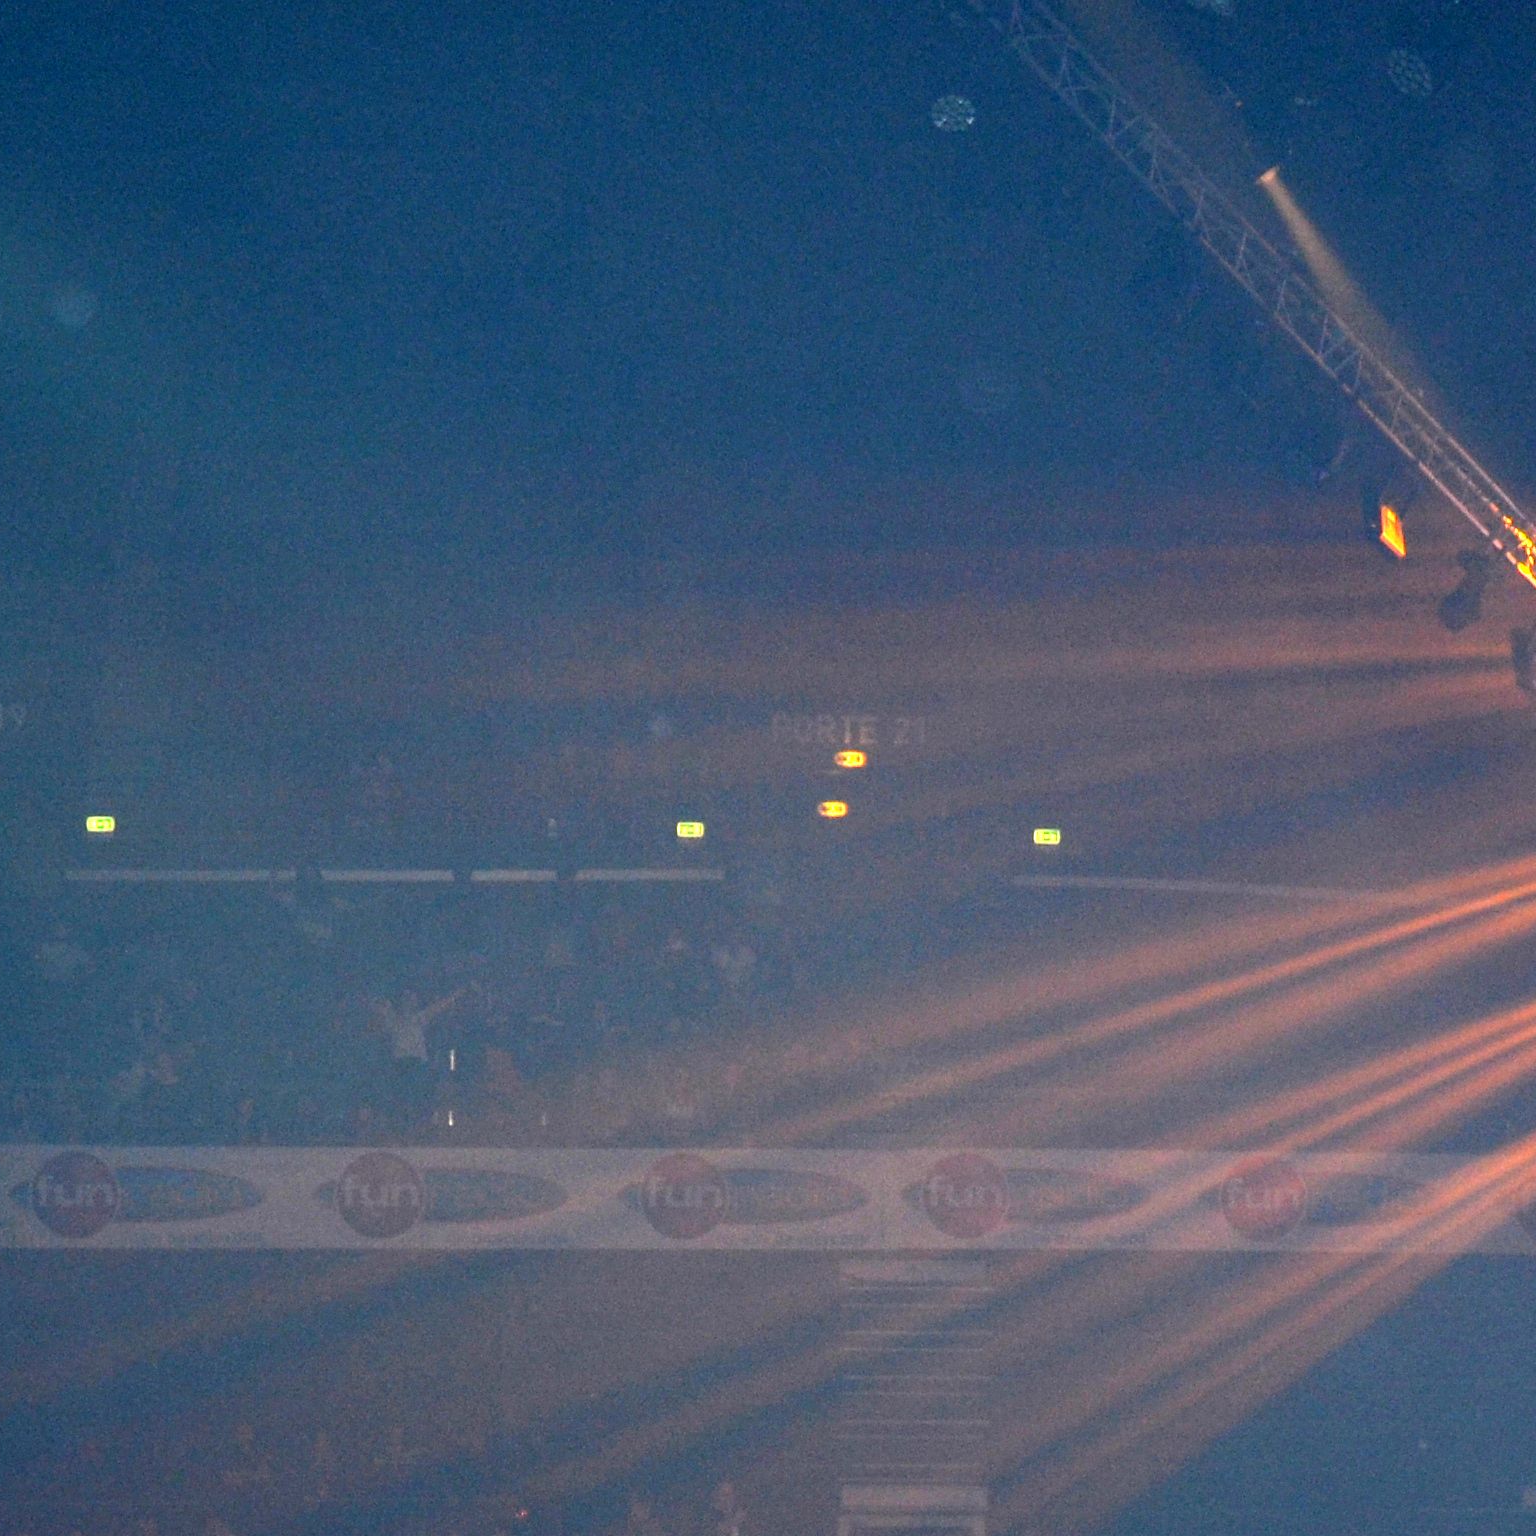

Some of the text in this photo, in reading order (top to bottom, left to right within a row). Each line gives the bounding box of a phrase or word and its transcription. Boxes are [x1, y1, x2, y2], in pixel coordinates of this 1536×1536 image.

[36, 1173, 115, 1207] fun
[342, 1173, 421, 1207] fun
[645, 1173, 723, 1208] fun
[928, 1173, 1003, 1208] fun
